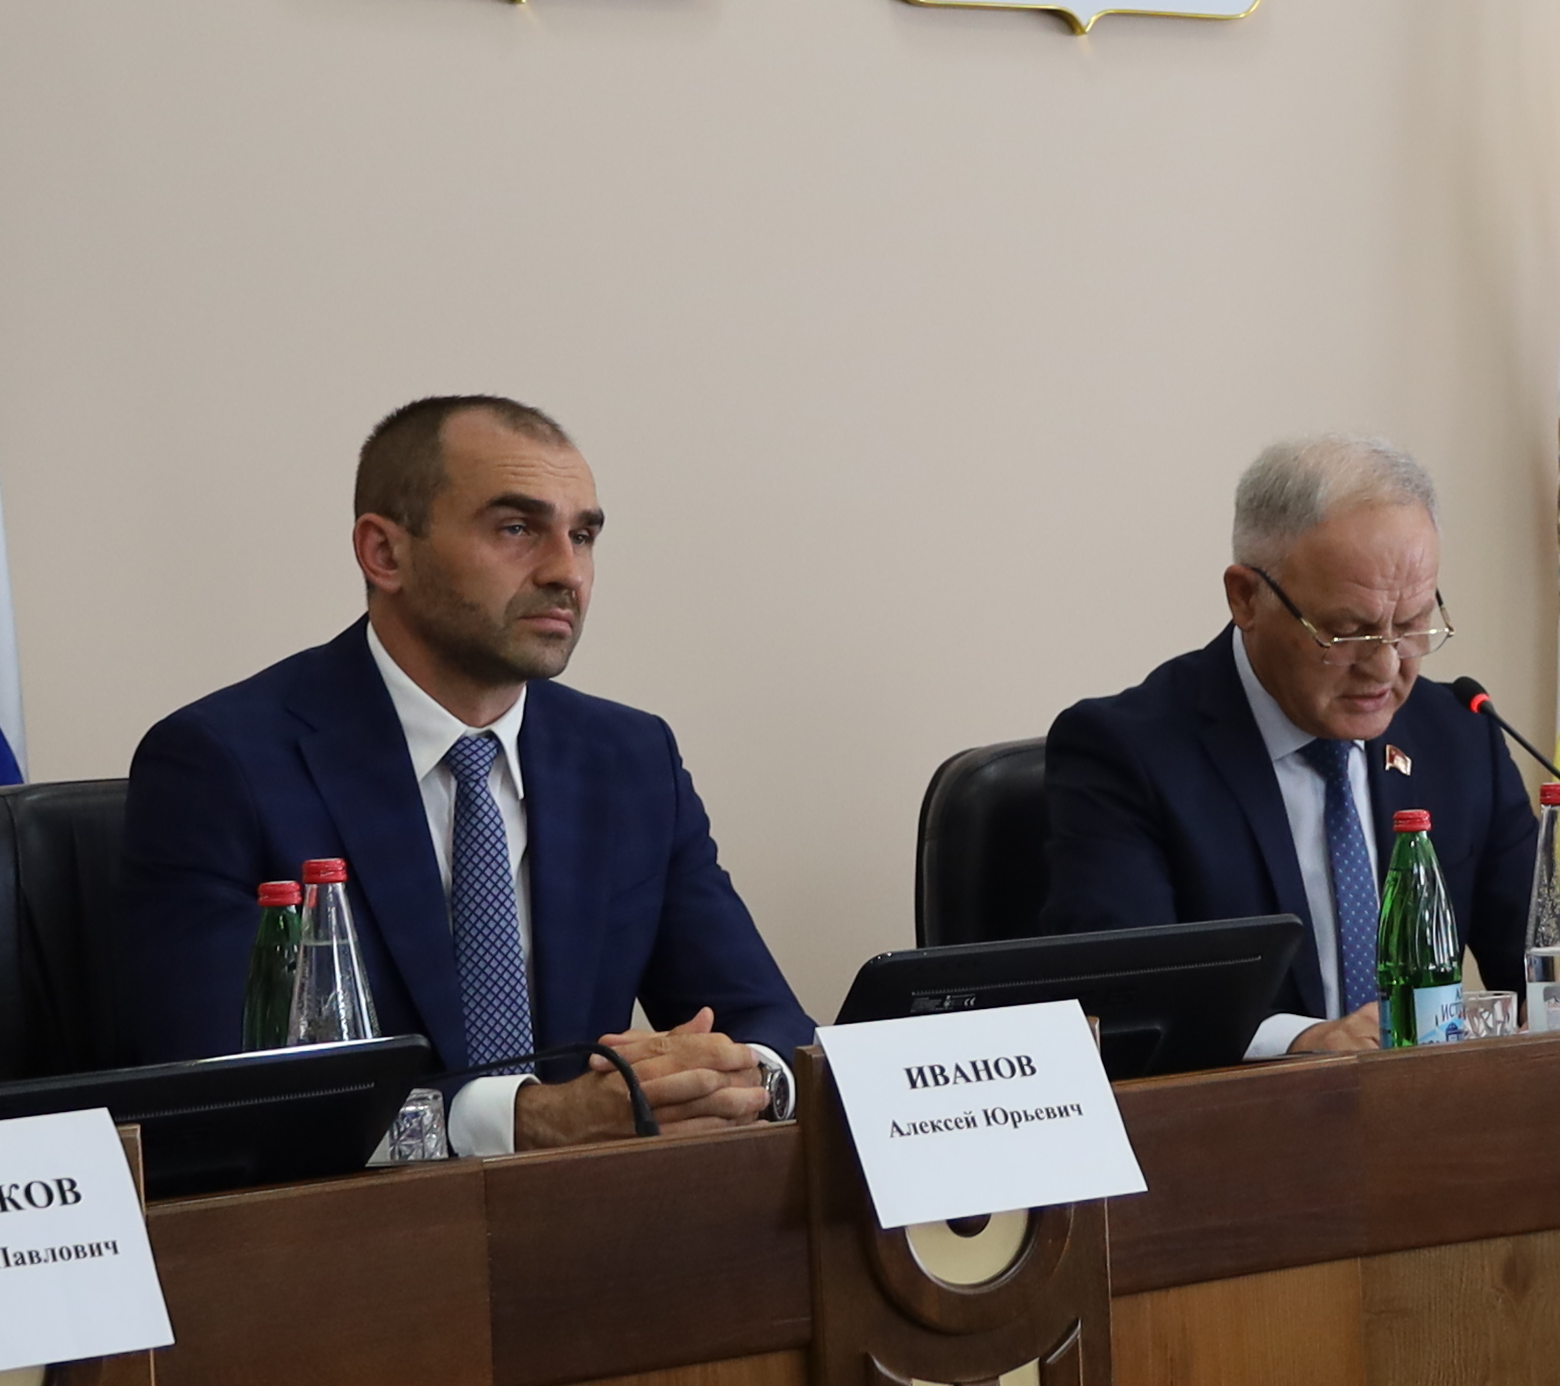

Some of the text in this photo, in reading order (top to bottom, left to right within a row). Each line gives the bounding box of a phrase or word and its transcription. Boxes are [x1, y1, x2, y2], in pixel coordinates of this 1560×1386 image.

[903, 1055, 1038, 1090] ИВАНОВ
[889, 1103, 1084, 1138] Алексей Юрьевич
